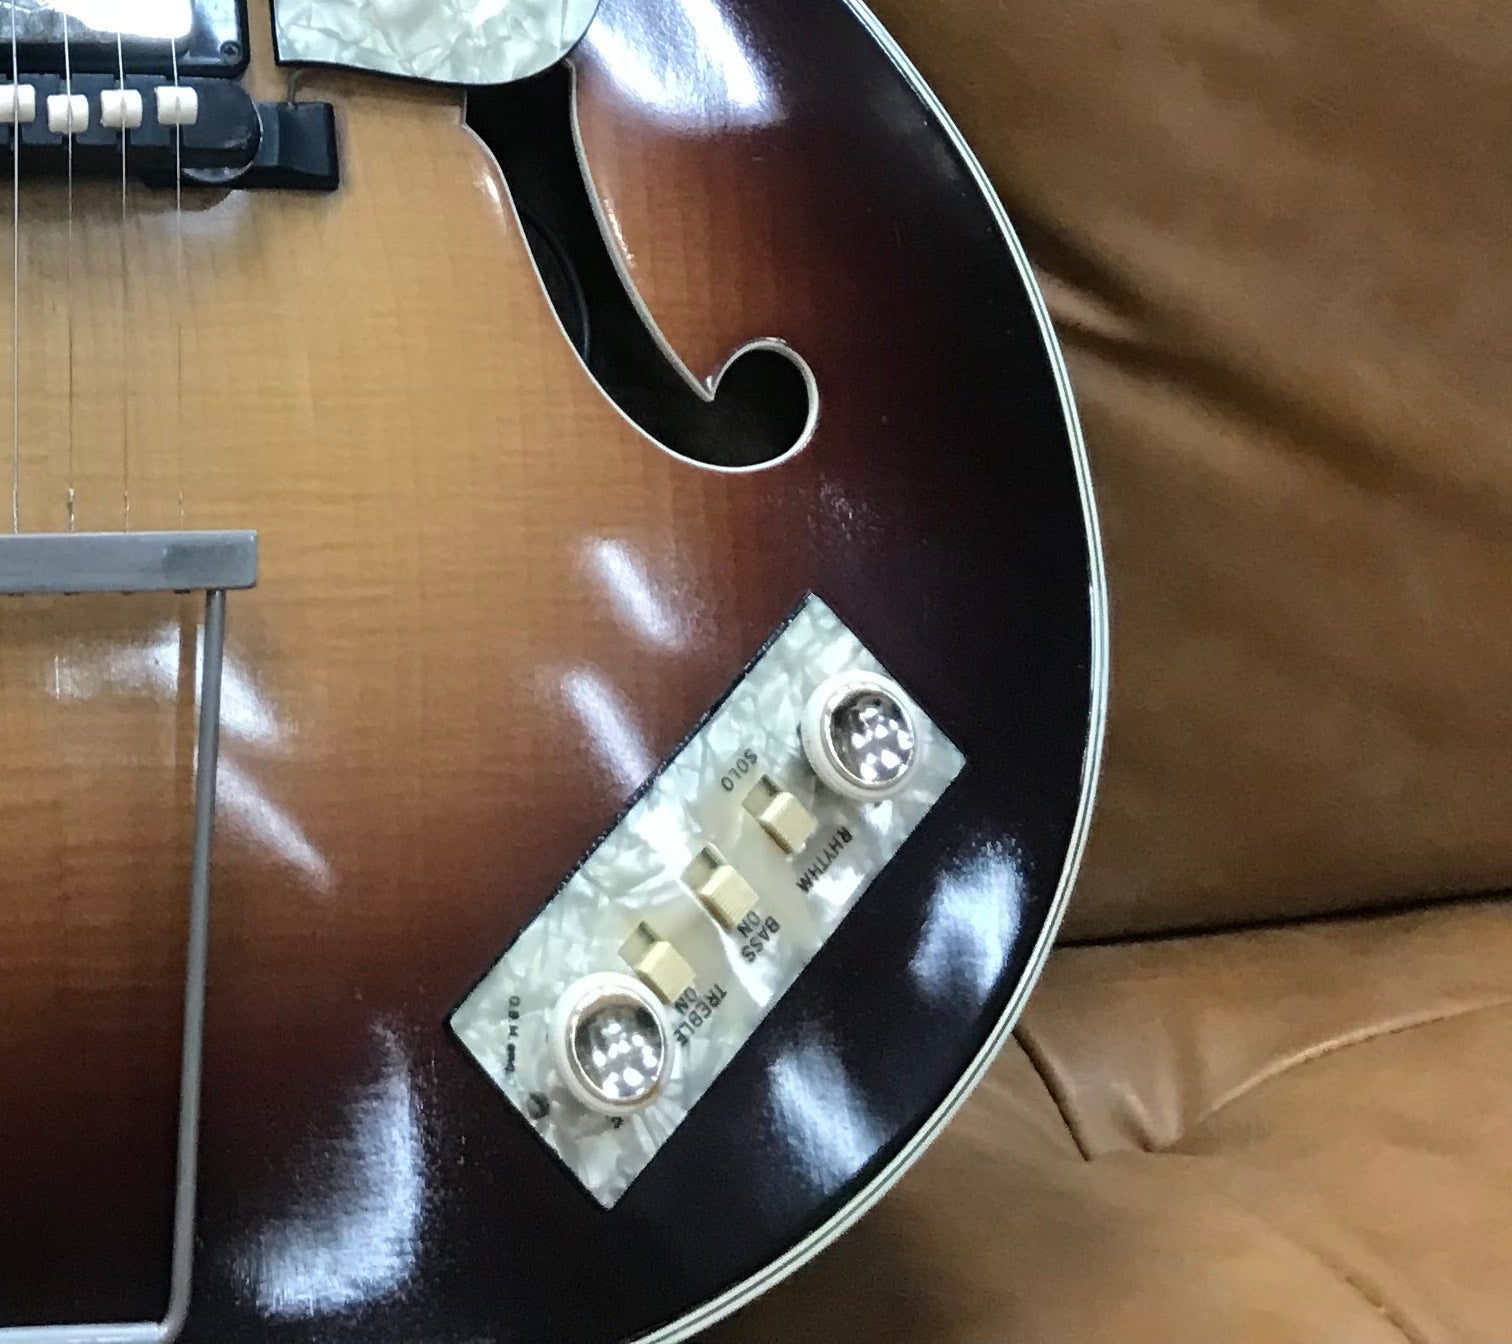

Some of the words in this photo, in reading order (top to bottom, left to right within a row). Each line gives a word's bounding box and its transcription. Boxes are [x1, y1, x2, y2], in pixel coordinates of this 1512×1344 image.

[721, 748, 758, 792] SOLO
[796, 826, 853, 893] RHYTHM
[737, 910, 761, 938] ON
[741, 915, 781, 963] BASS
[673, 983, 728, 1048] TREBLE
[674, 986, 698, 1015] ON
